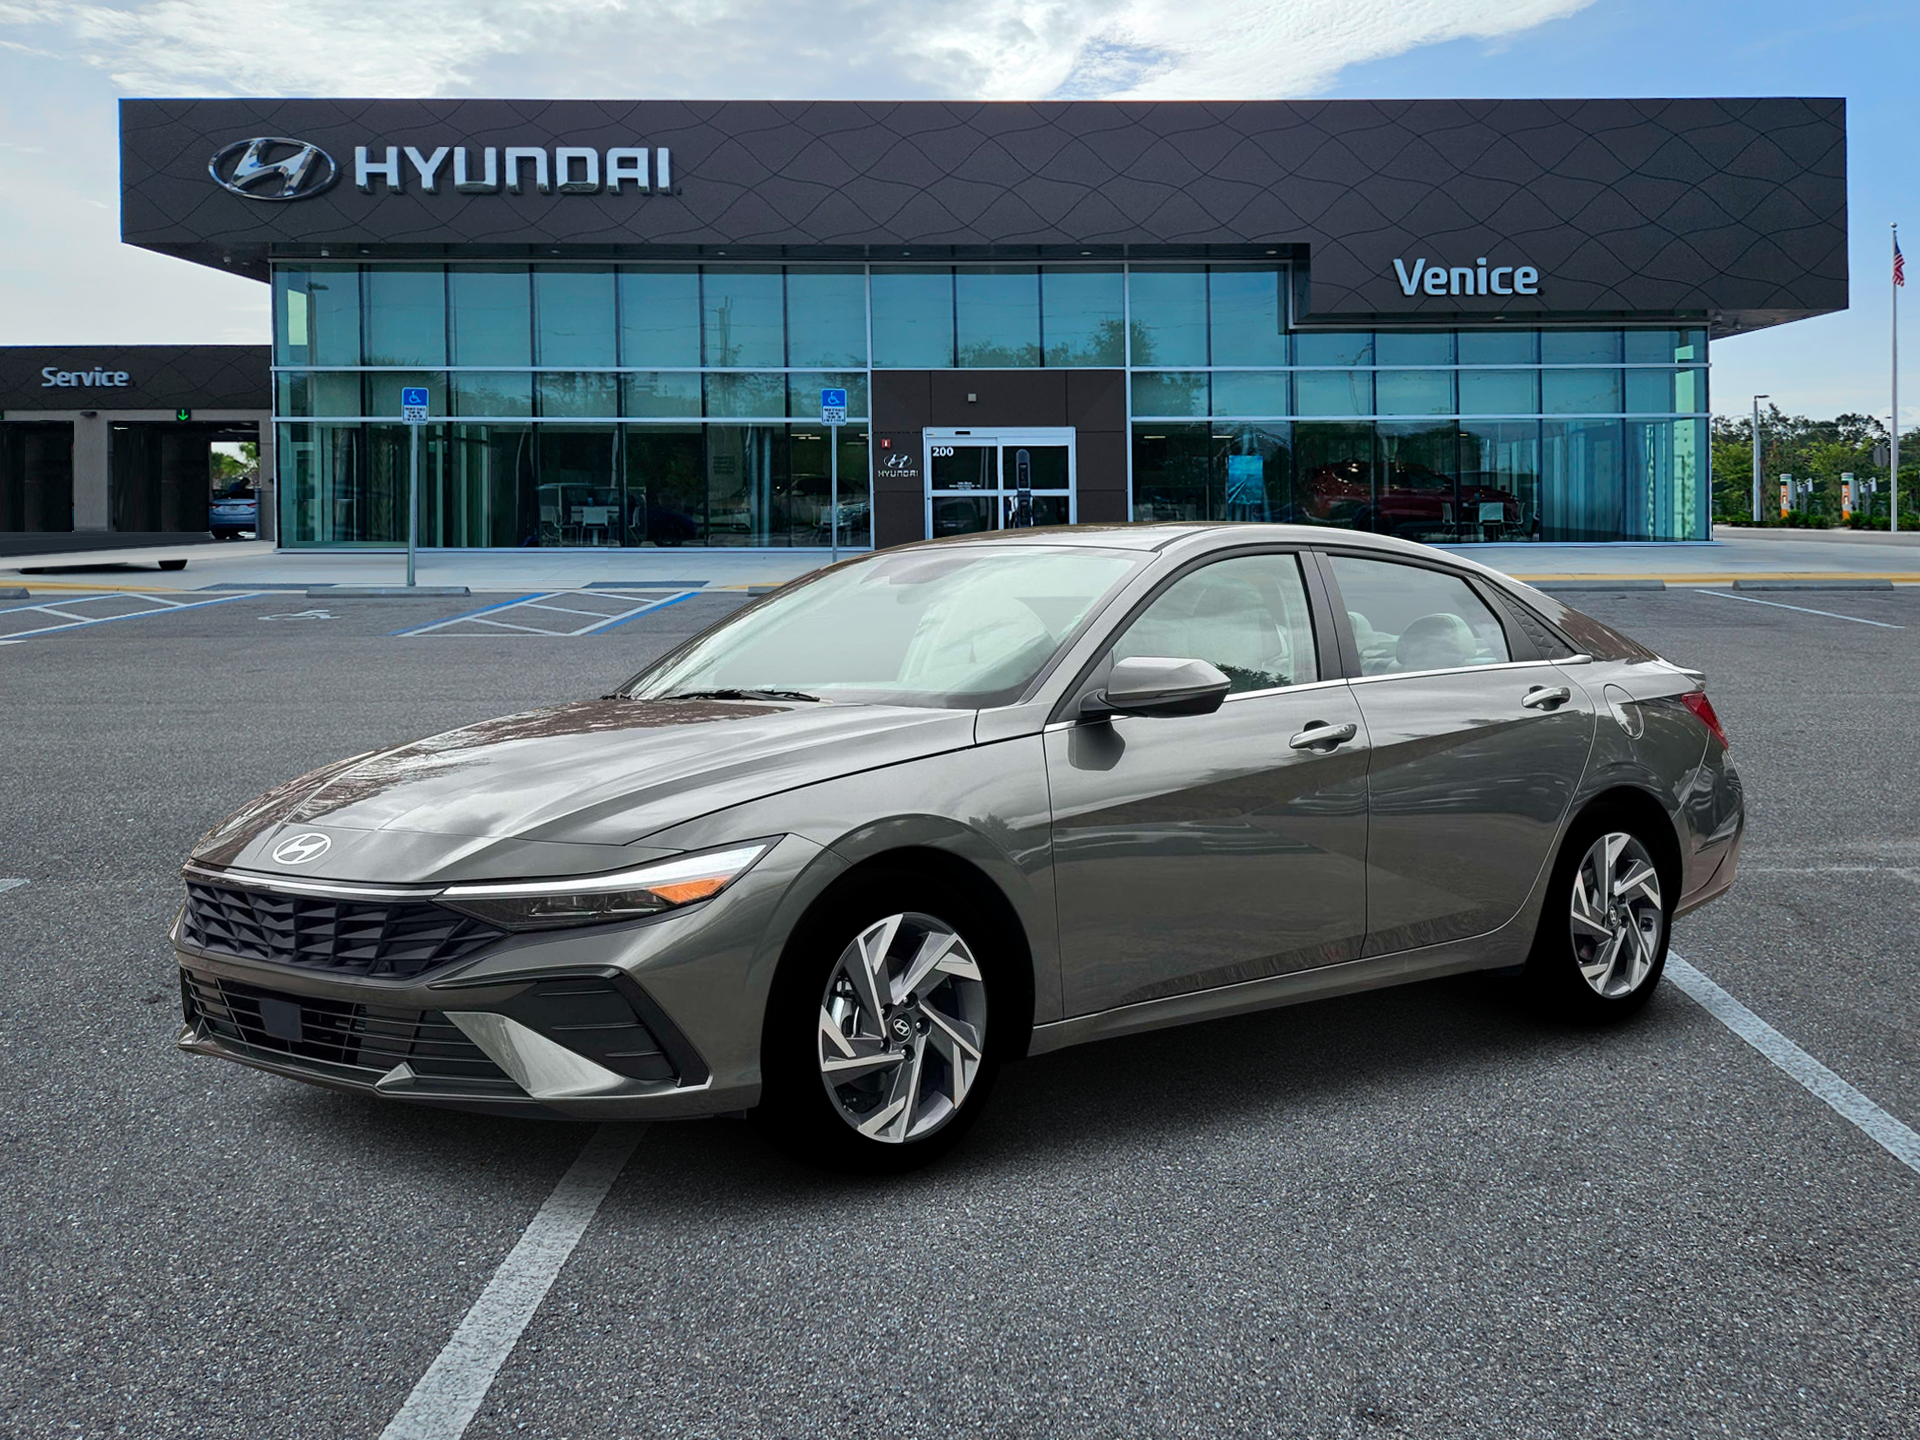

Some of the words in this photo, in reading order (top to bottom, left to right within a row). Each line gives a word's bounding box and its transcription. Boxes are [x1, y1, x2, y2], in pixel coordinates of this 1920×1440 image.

[354, 146, 672, 194] HYUNDAI
[1392, 257, 1539, 296] Venice
[41, 366, 130, 387] Service
[932, 446, 954, 457] 200
